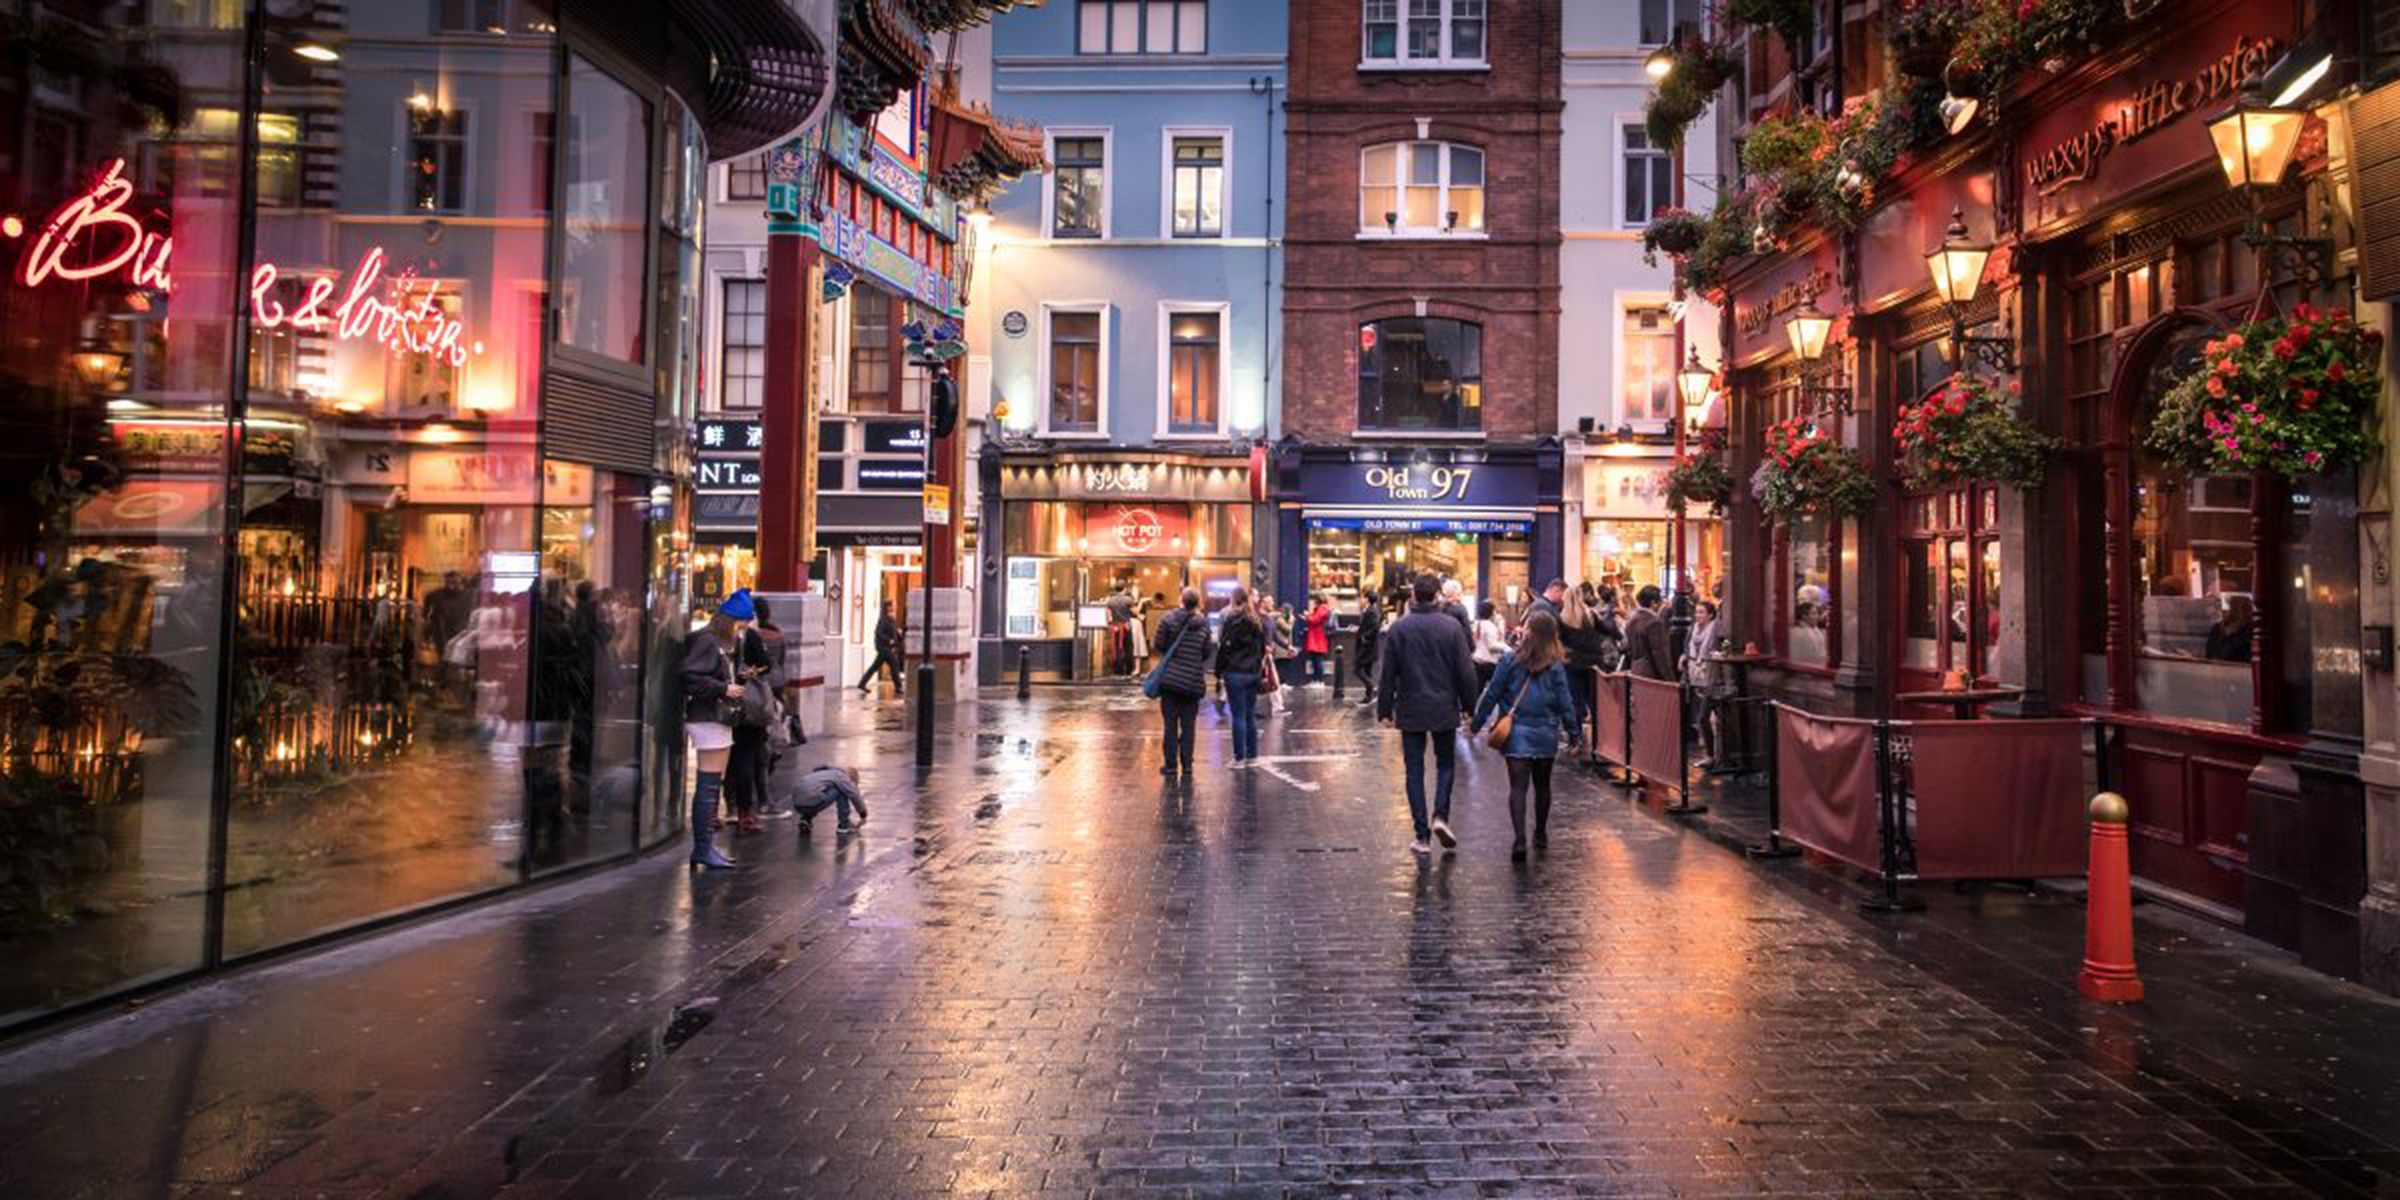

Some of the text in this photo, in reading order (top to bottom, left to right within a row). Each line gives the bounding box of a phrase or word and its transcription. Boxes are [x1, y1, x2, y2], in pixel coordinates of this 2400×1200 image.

[291, 277, 333, 332] &
[1365, 467, 1472, 500] Old Town 97
[1139, 524, 1164, 538] POT
